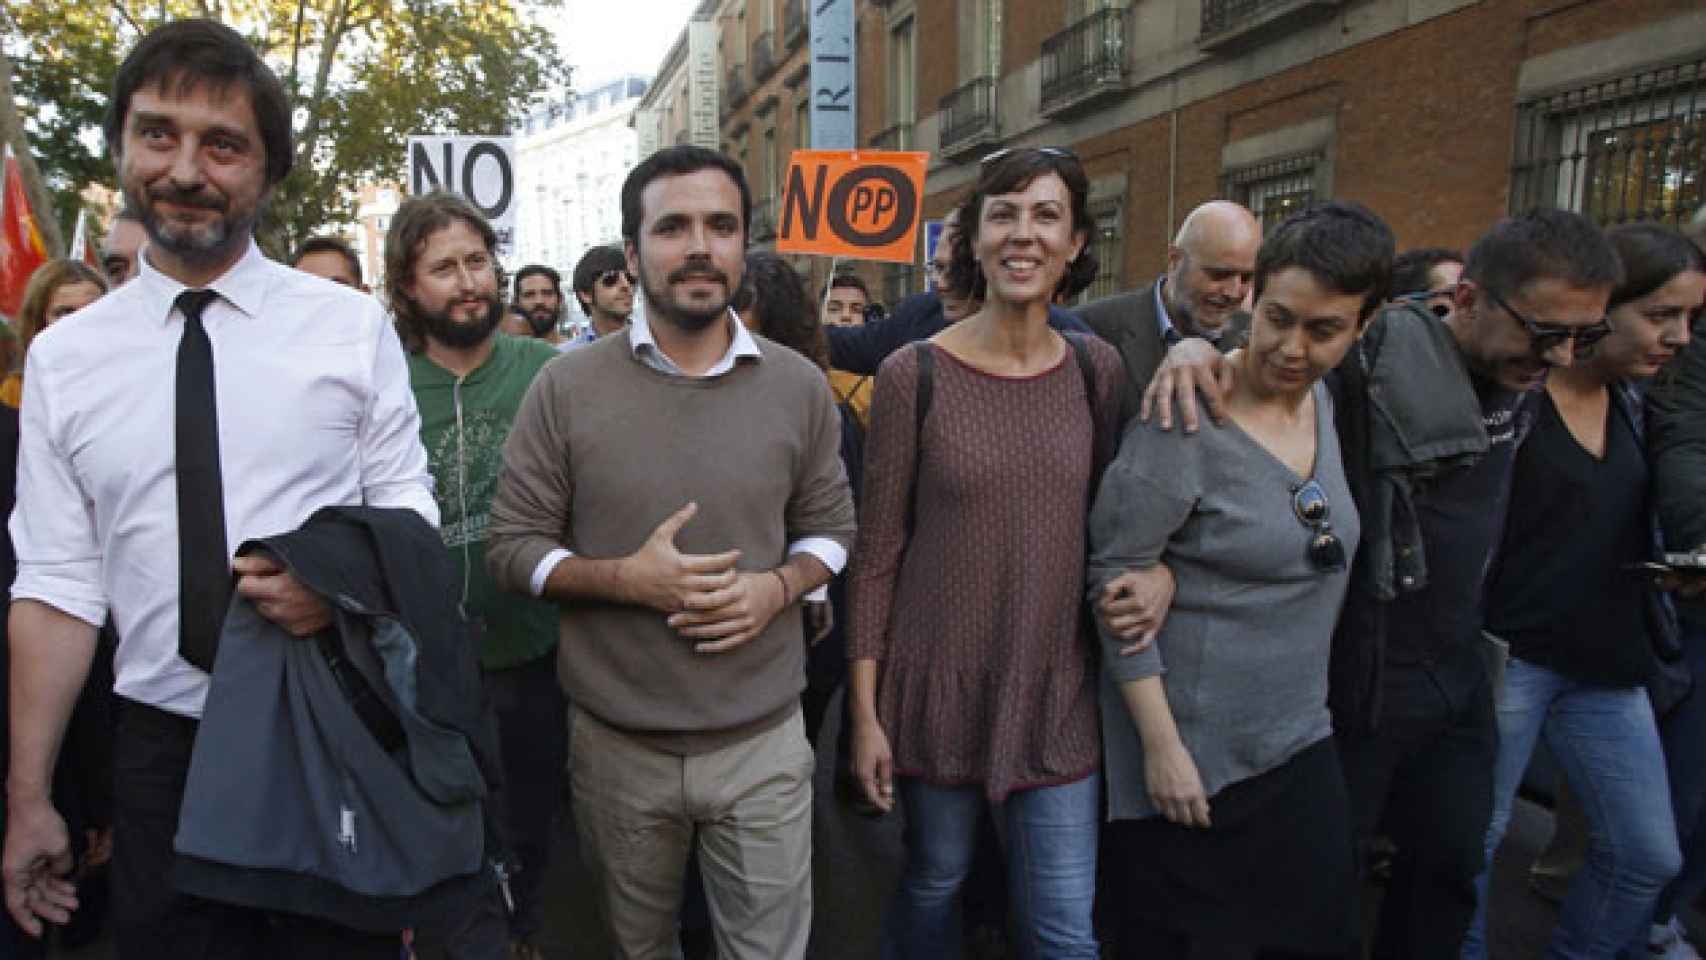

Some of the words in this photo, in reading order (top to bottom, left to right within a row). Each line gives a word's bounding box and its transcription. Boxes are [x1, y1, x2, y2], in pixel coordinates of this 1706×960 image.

[412, 141, 513, 220] NO
[780, 164, 917, 247] NO
[850, 186, 896, 225] PP
